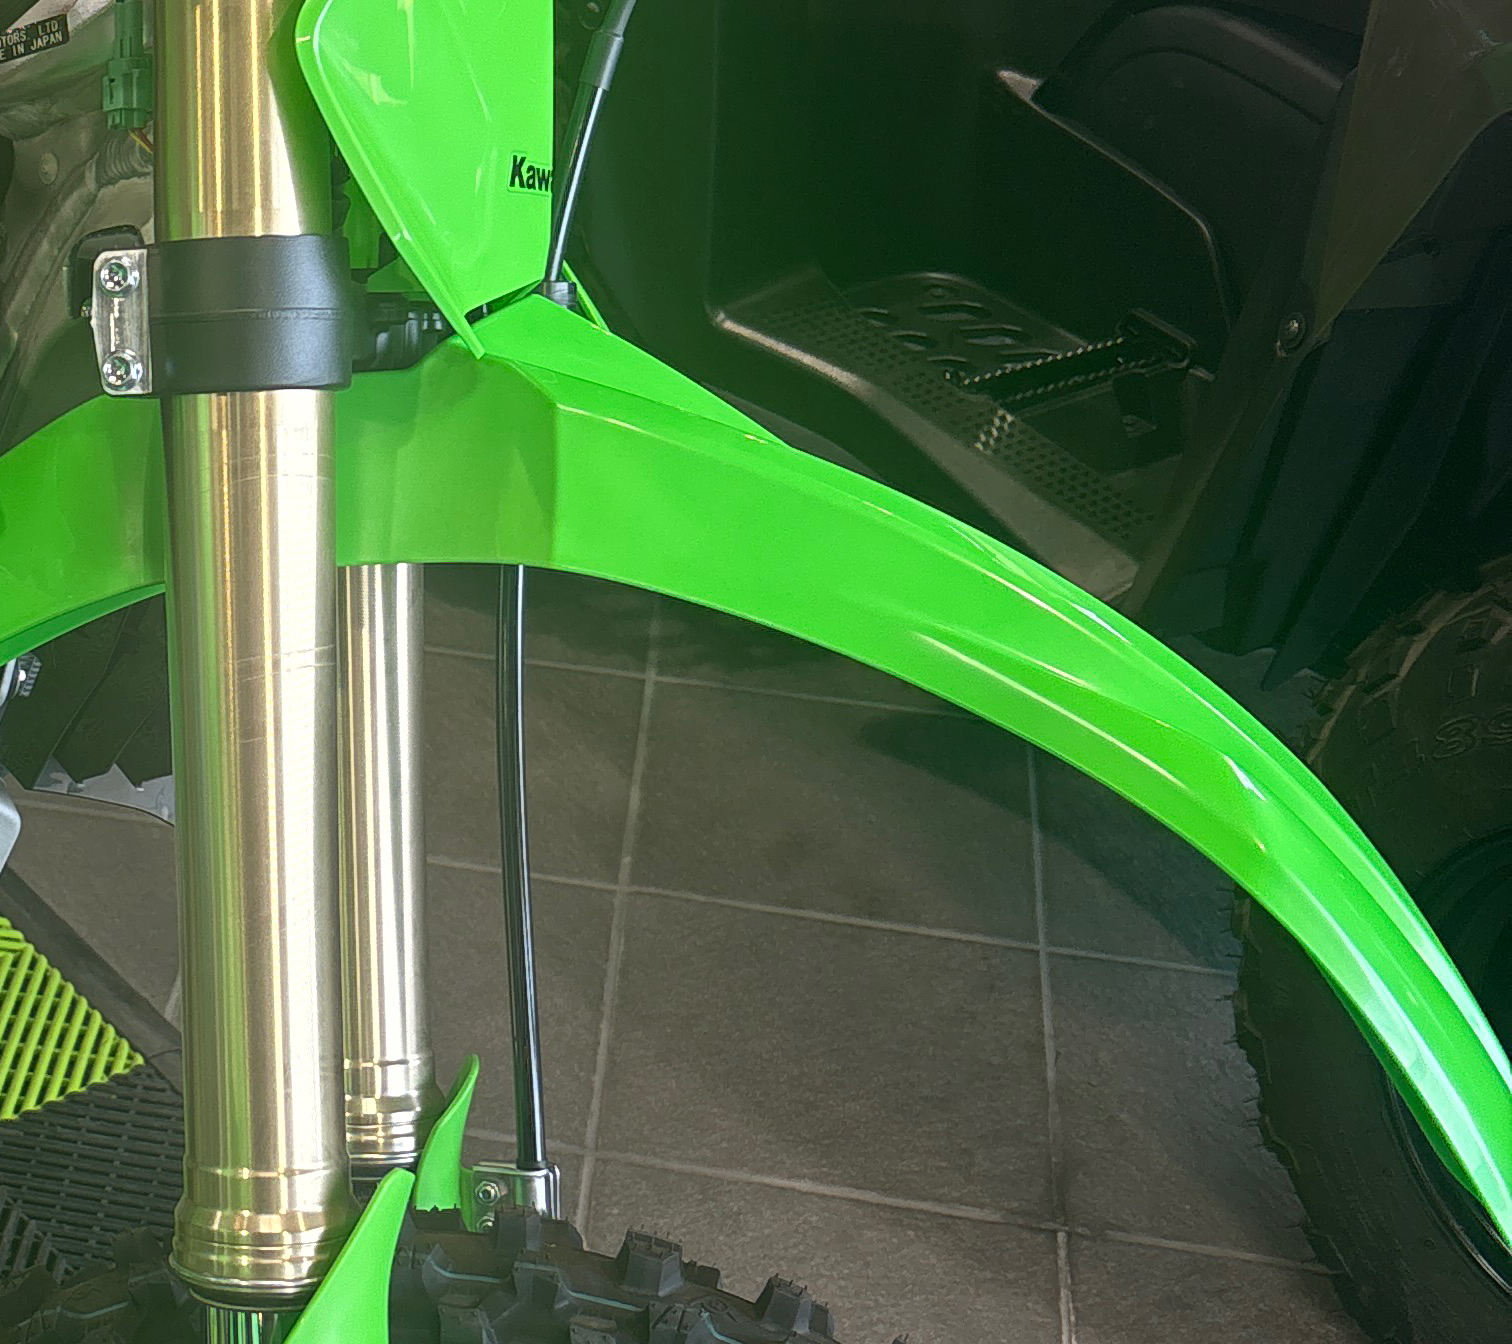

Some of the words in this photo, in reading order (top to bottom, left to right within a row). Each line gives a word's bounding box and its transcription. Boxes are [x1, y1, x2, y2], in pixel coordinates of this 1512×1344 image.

[11, 41, 25, 56] IN
[30, 30, 63, 51] JAPAN
[509, 154, 552, 193] Kaw
